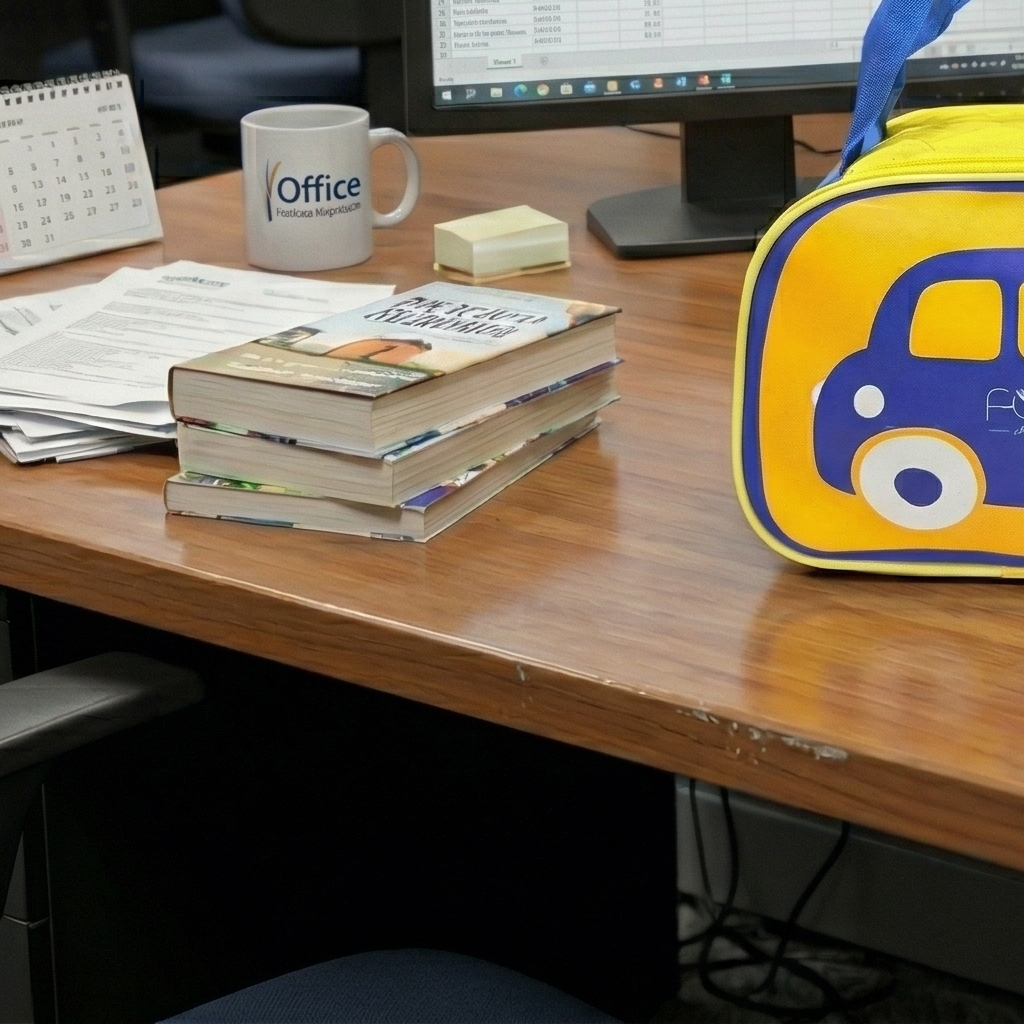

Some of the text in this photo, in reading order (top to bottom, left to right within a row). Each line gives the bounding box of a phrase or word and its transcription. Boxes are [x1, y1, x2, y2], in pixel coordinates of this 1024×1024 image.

[53, 159, 60, 167] 7
[56, 176, 67, 185] 14
[277, 174, 361, 204] Office
[60, 193, 71, 203] 19
